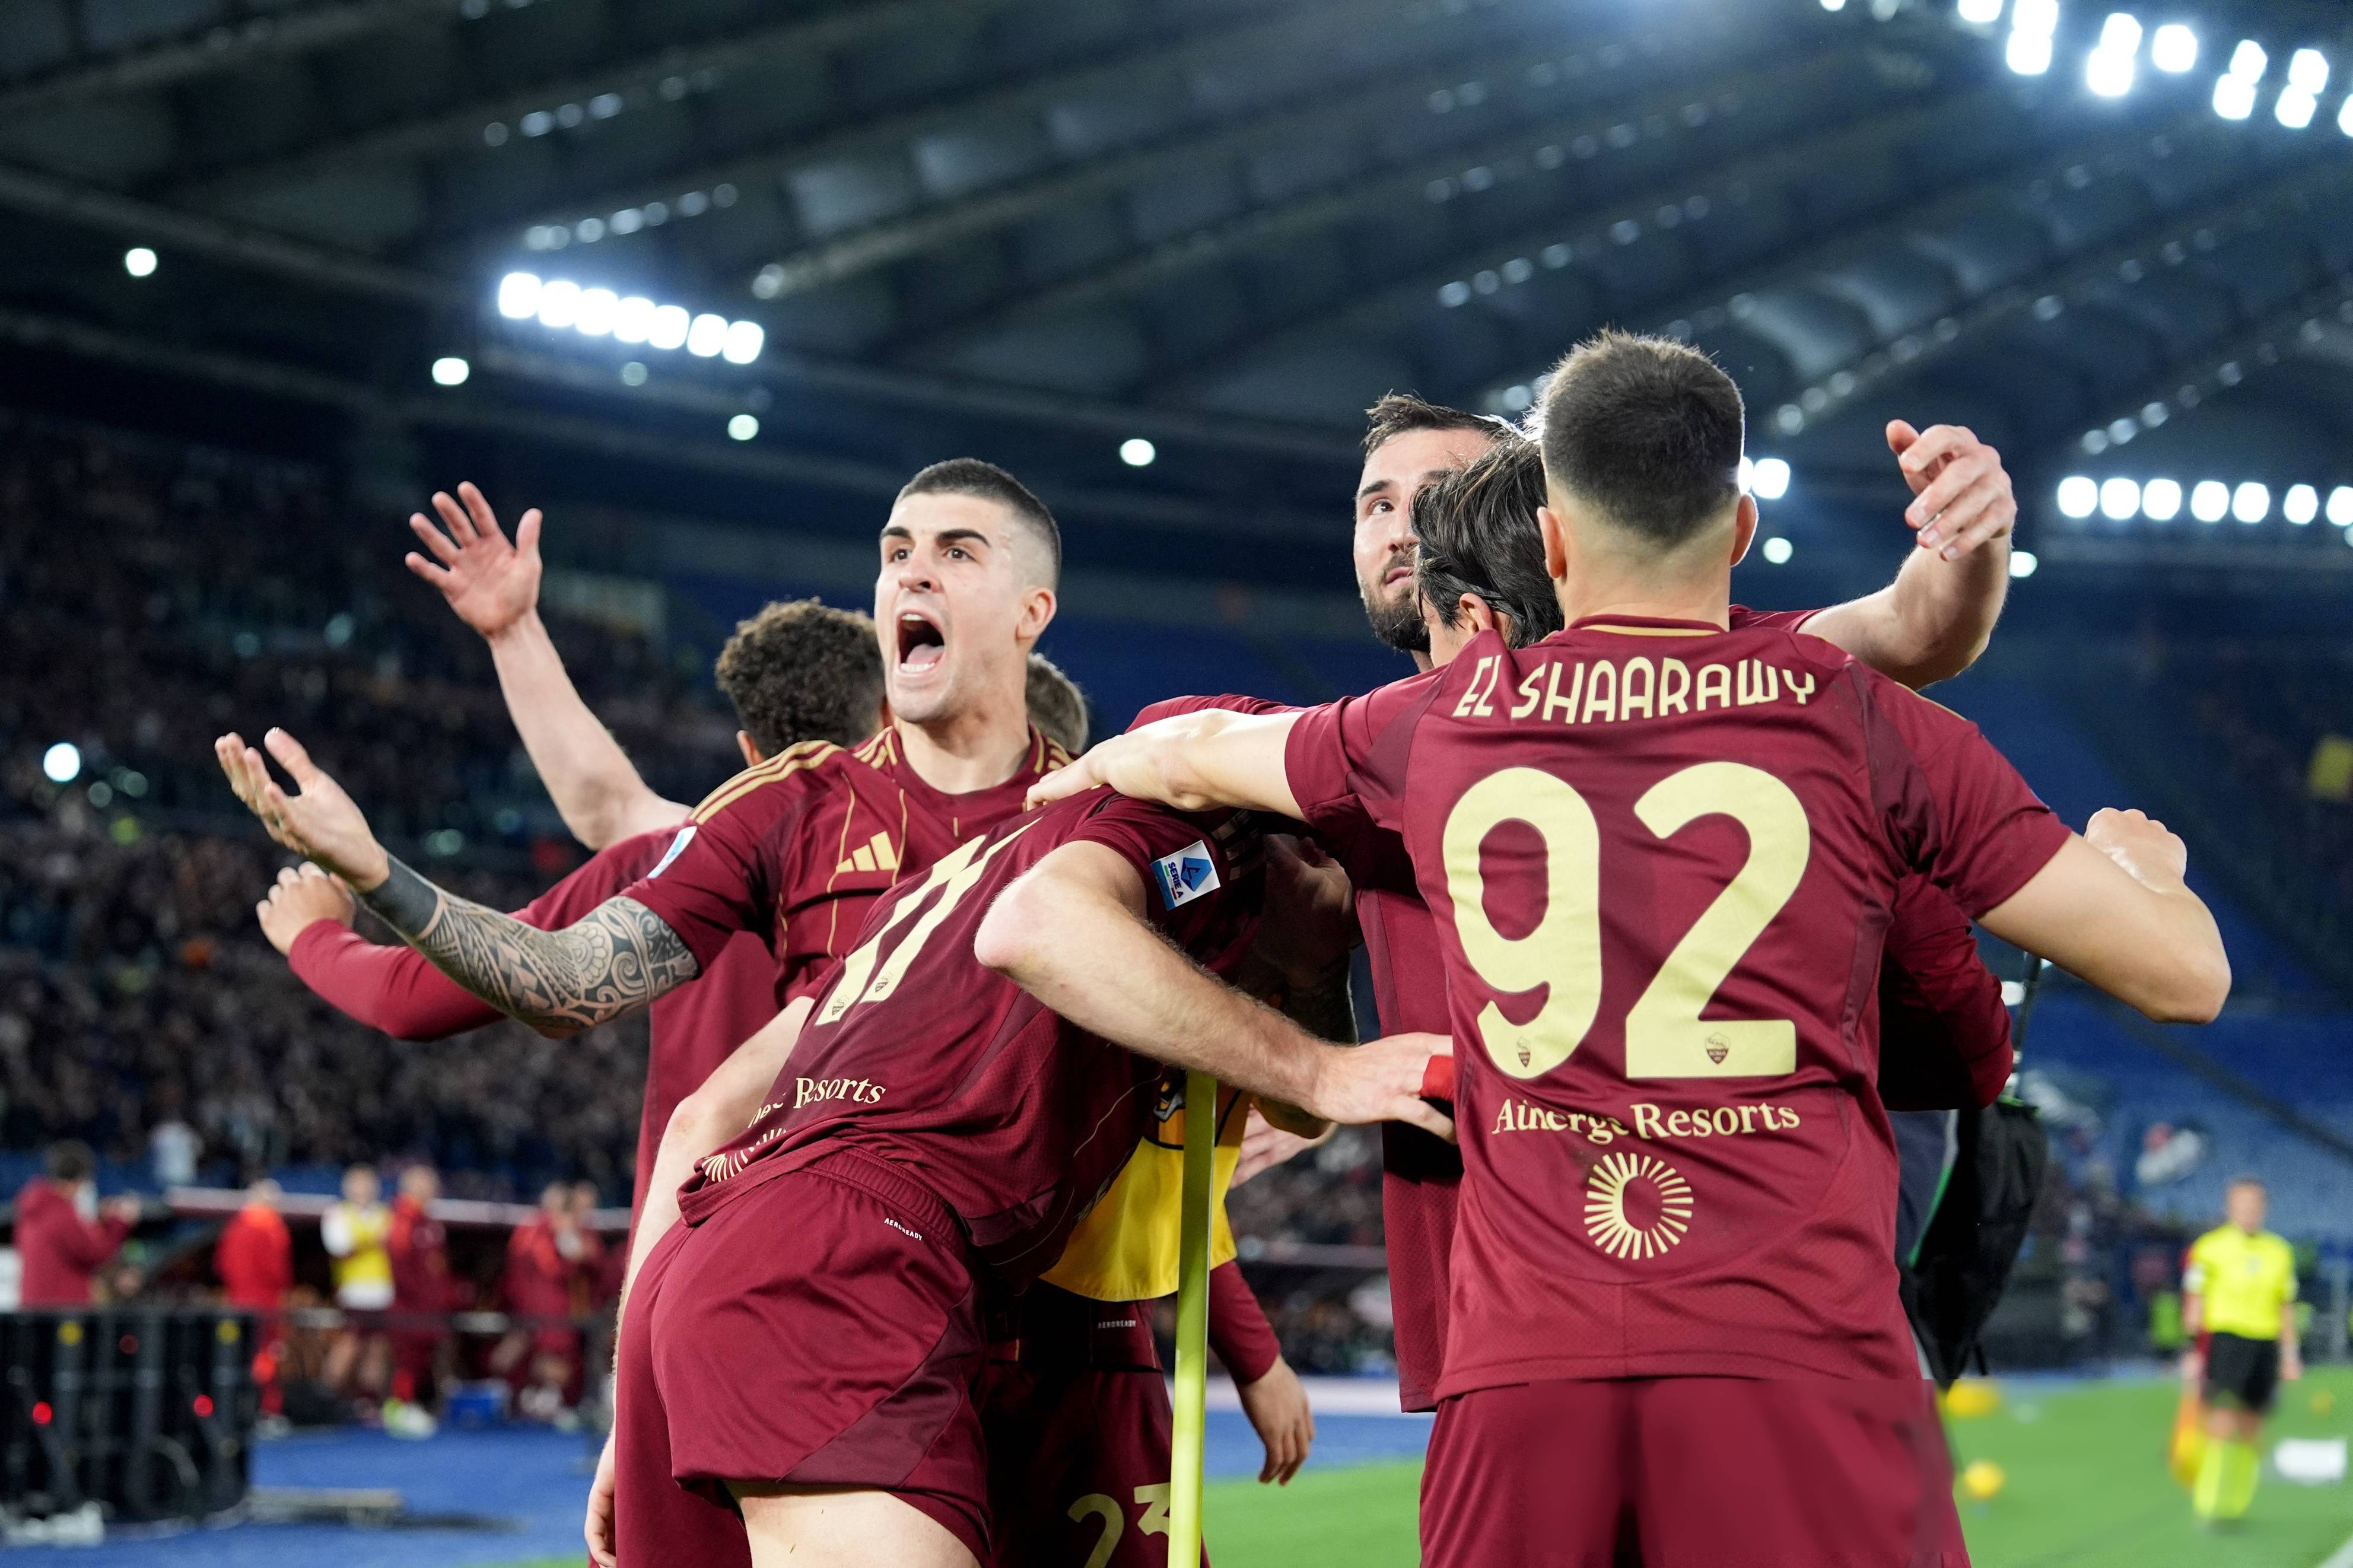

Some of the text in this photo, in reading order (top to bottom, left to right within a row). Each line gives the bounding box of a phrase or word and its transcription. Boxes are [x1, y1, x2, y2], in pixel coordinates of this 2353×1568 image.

[1452, 654, 1815, 724] EL SHAARAWY
[1168, 861, 1182, 889] SERIE
[1442, 761, 1811, 1080] 92
[1630, 1102, 1801, 1140] Resorts
[883, 1217, 923, 1241] AEROREADY
